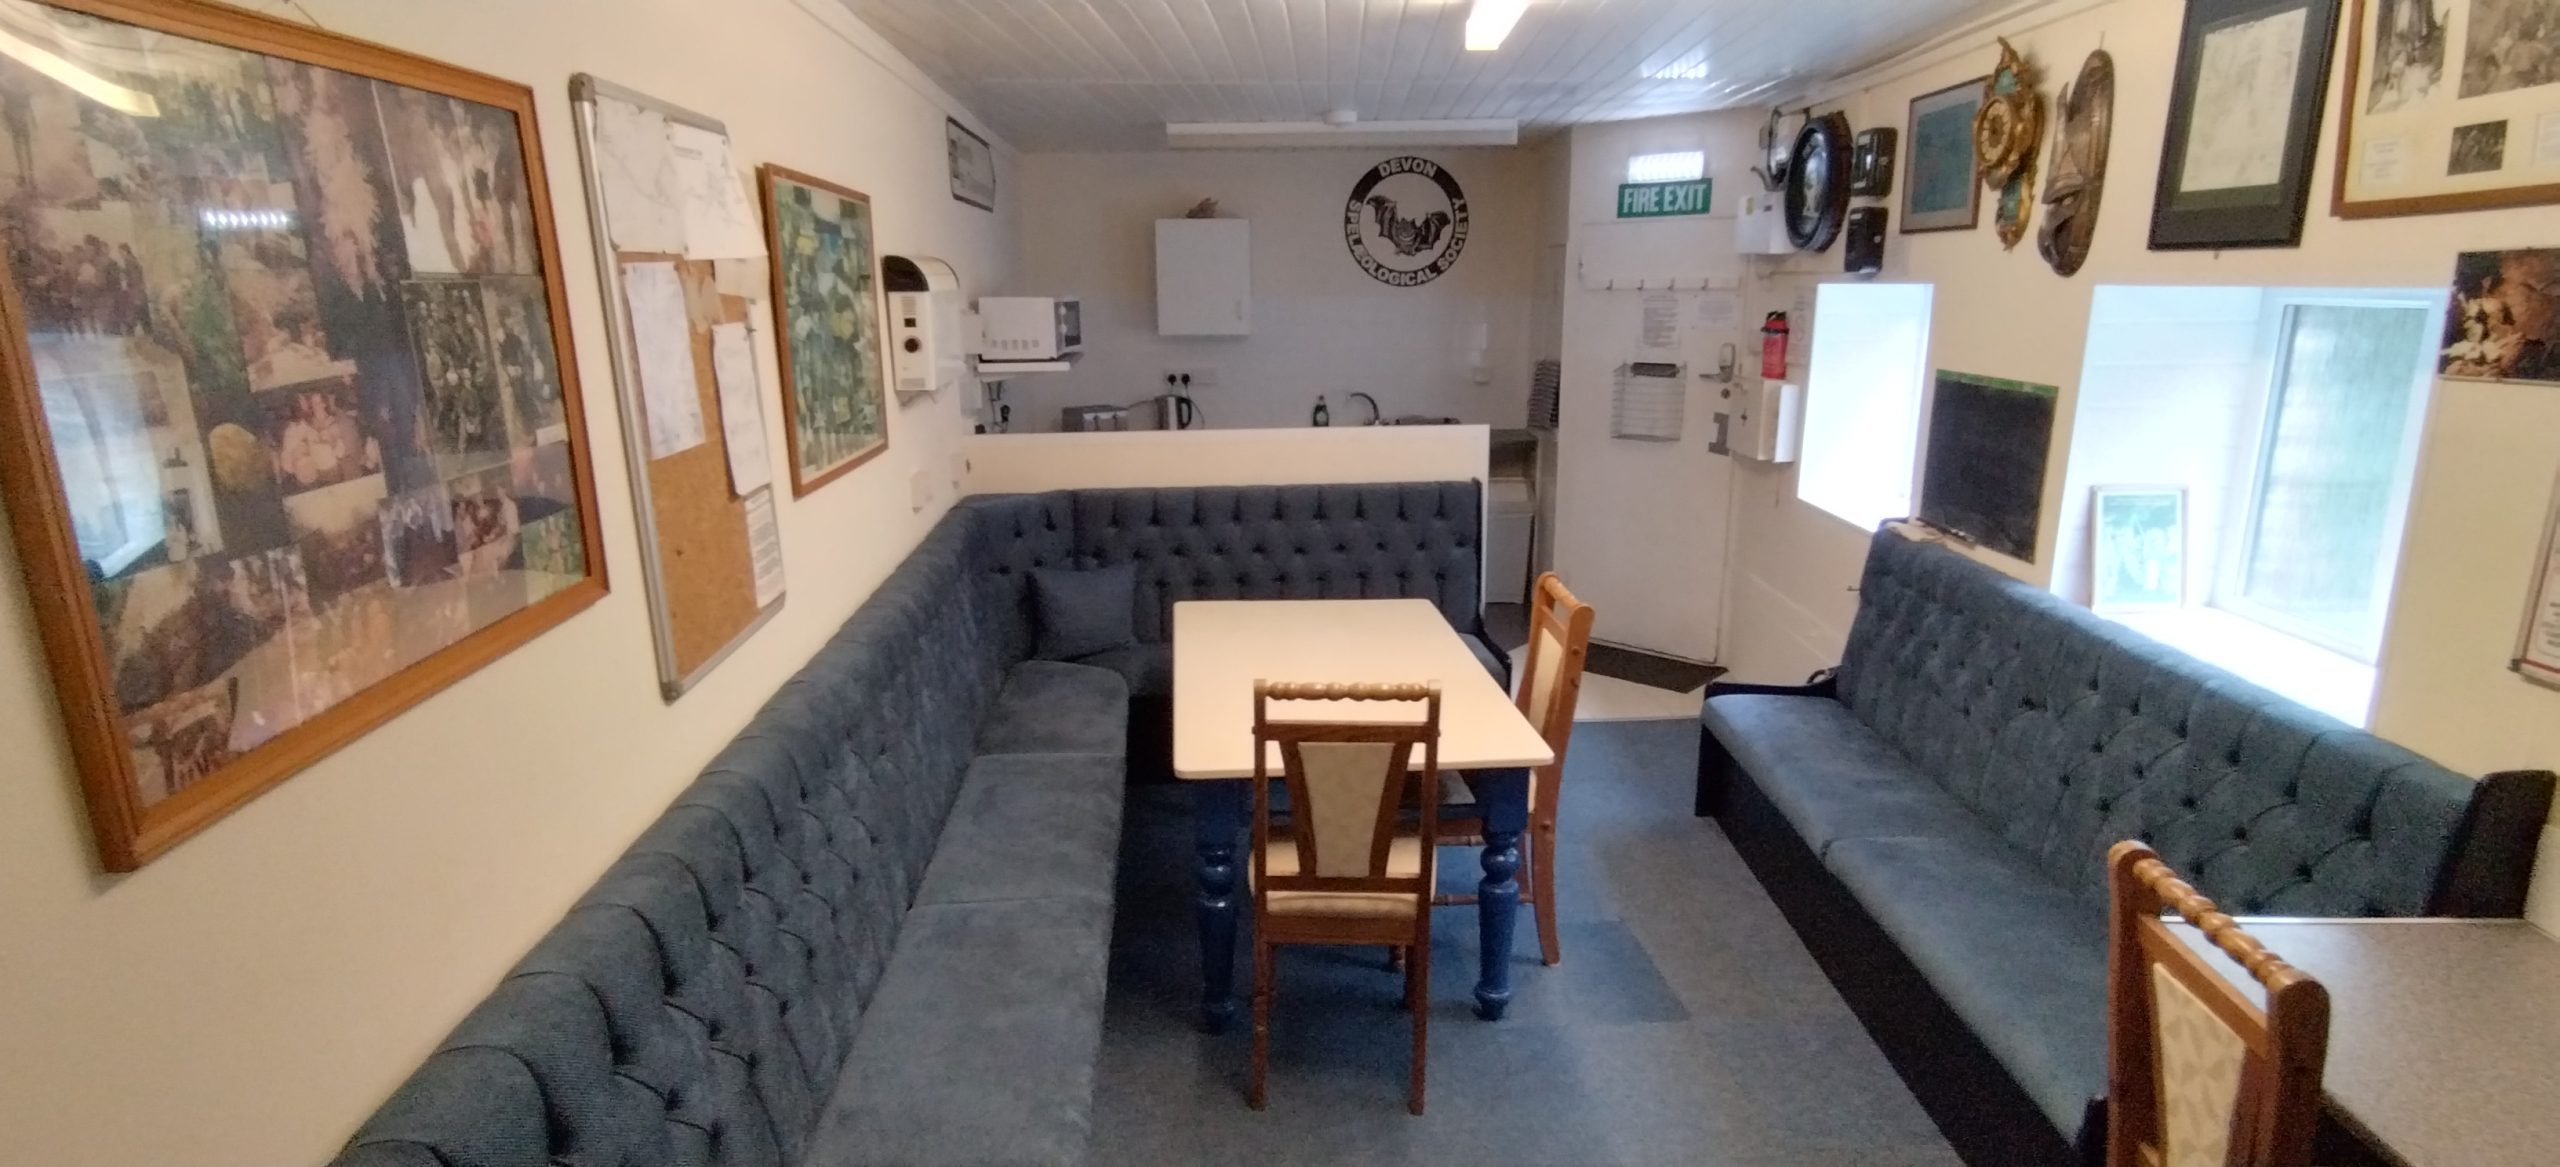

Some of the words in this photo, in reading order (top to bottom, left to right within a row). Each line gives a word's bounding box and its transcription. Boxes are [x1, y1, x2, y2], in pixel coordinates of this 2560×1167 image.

[1378, 157, 1437, 178] DEVON
[1623, 187, 1660, 213] FIRE
[1663, 183, 1708, 212] EXIT
[1437, 198, 1468, 271] SOCIETY
